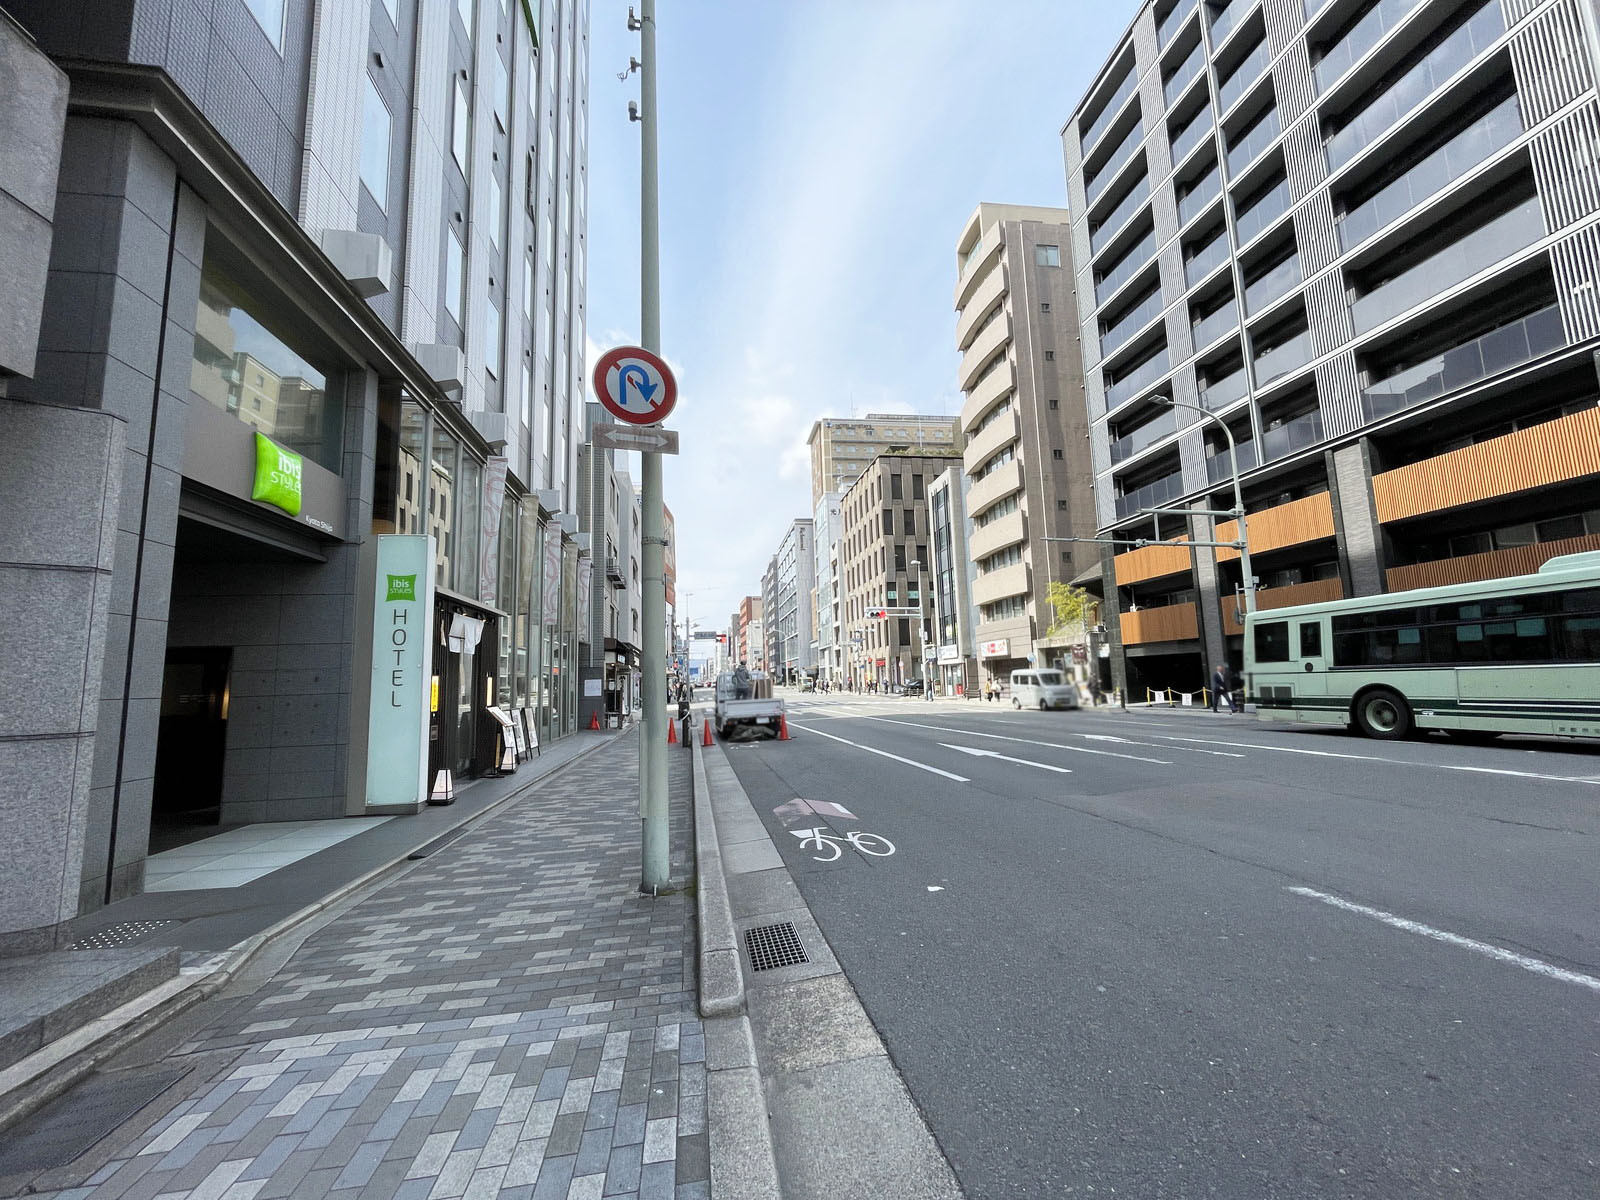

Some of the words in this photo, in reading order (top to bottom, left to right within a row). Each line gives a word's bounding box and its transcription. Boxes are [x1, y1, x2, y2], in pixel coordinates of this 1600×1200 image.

[278, 451, 301, 480] ibis
[392, 579, 410, 588] ibis
[392, 608, 407, 708] HOTEL
